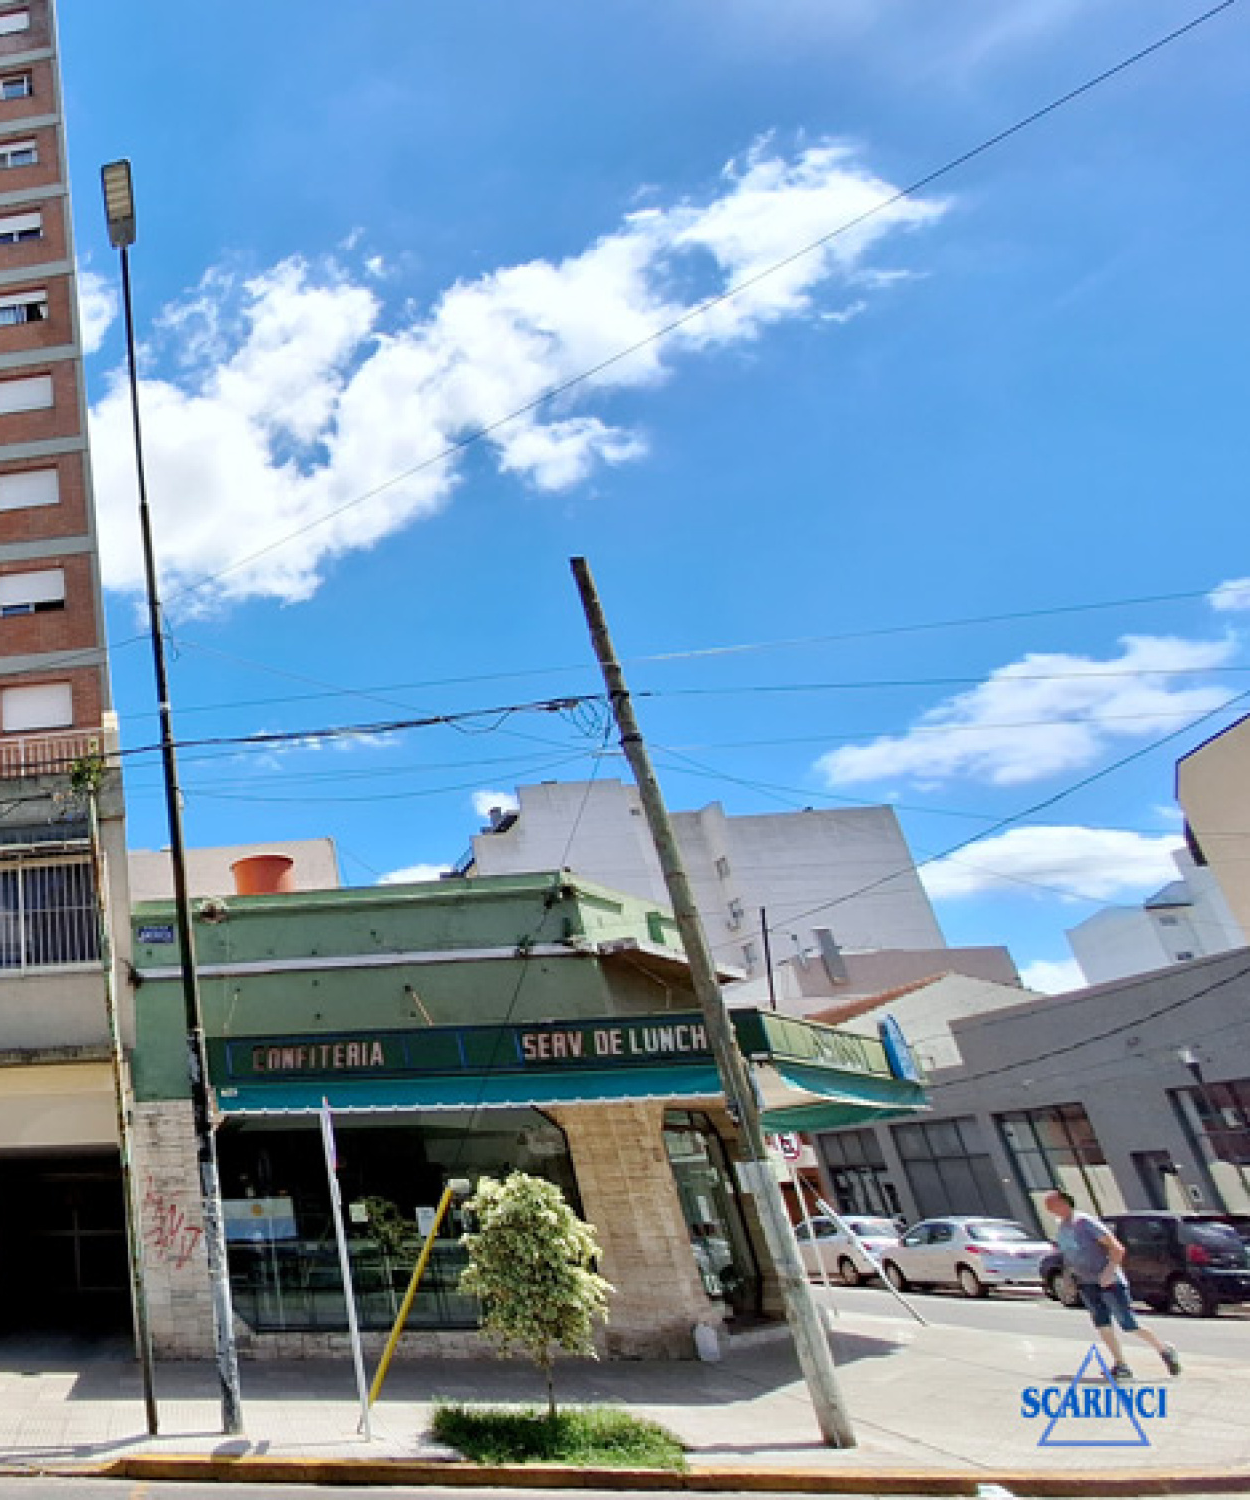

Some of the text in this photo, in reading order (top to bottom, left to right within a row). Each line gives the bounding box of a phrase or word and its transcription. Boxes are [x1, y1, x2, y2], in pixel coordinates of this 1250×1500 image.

[594, 1030, 623, 1056] DE
[629, 1025, 707, 1053] LUNCH
[252, 1041, 385, 1071] CONFITERIA
